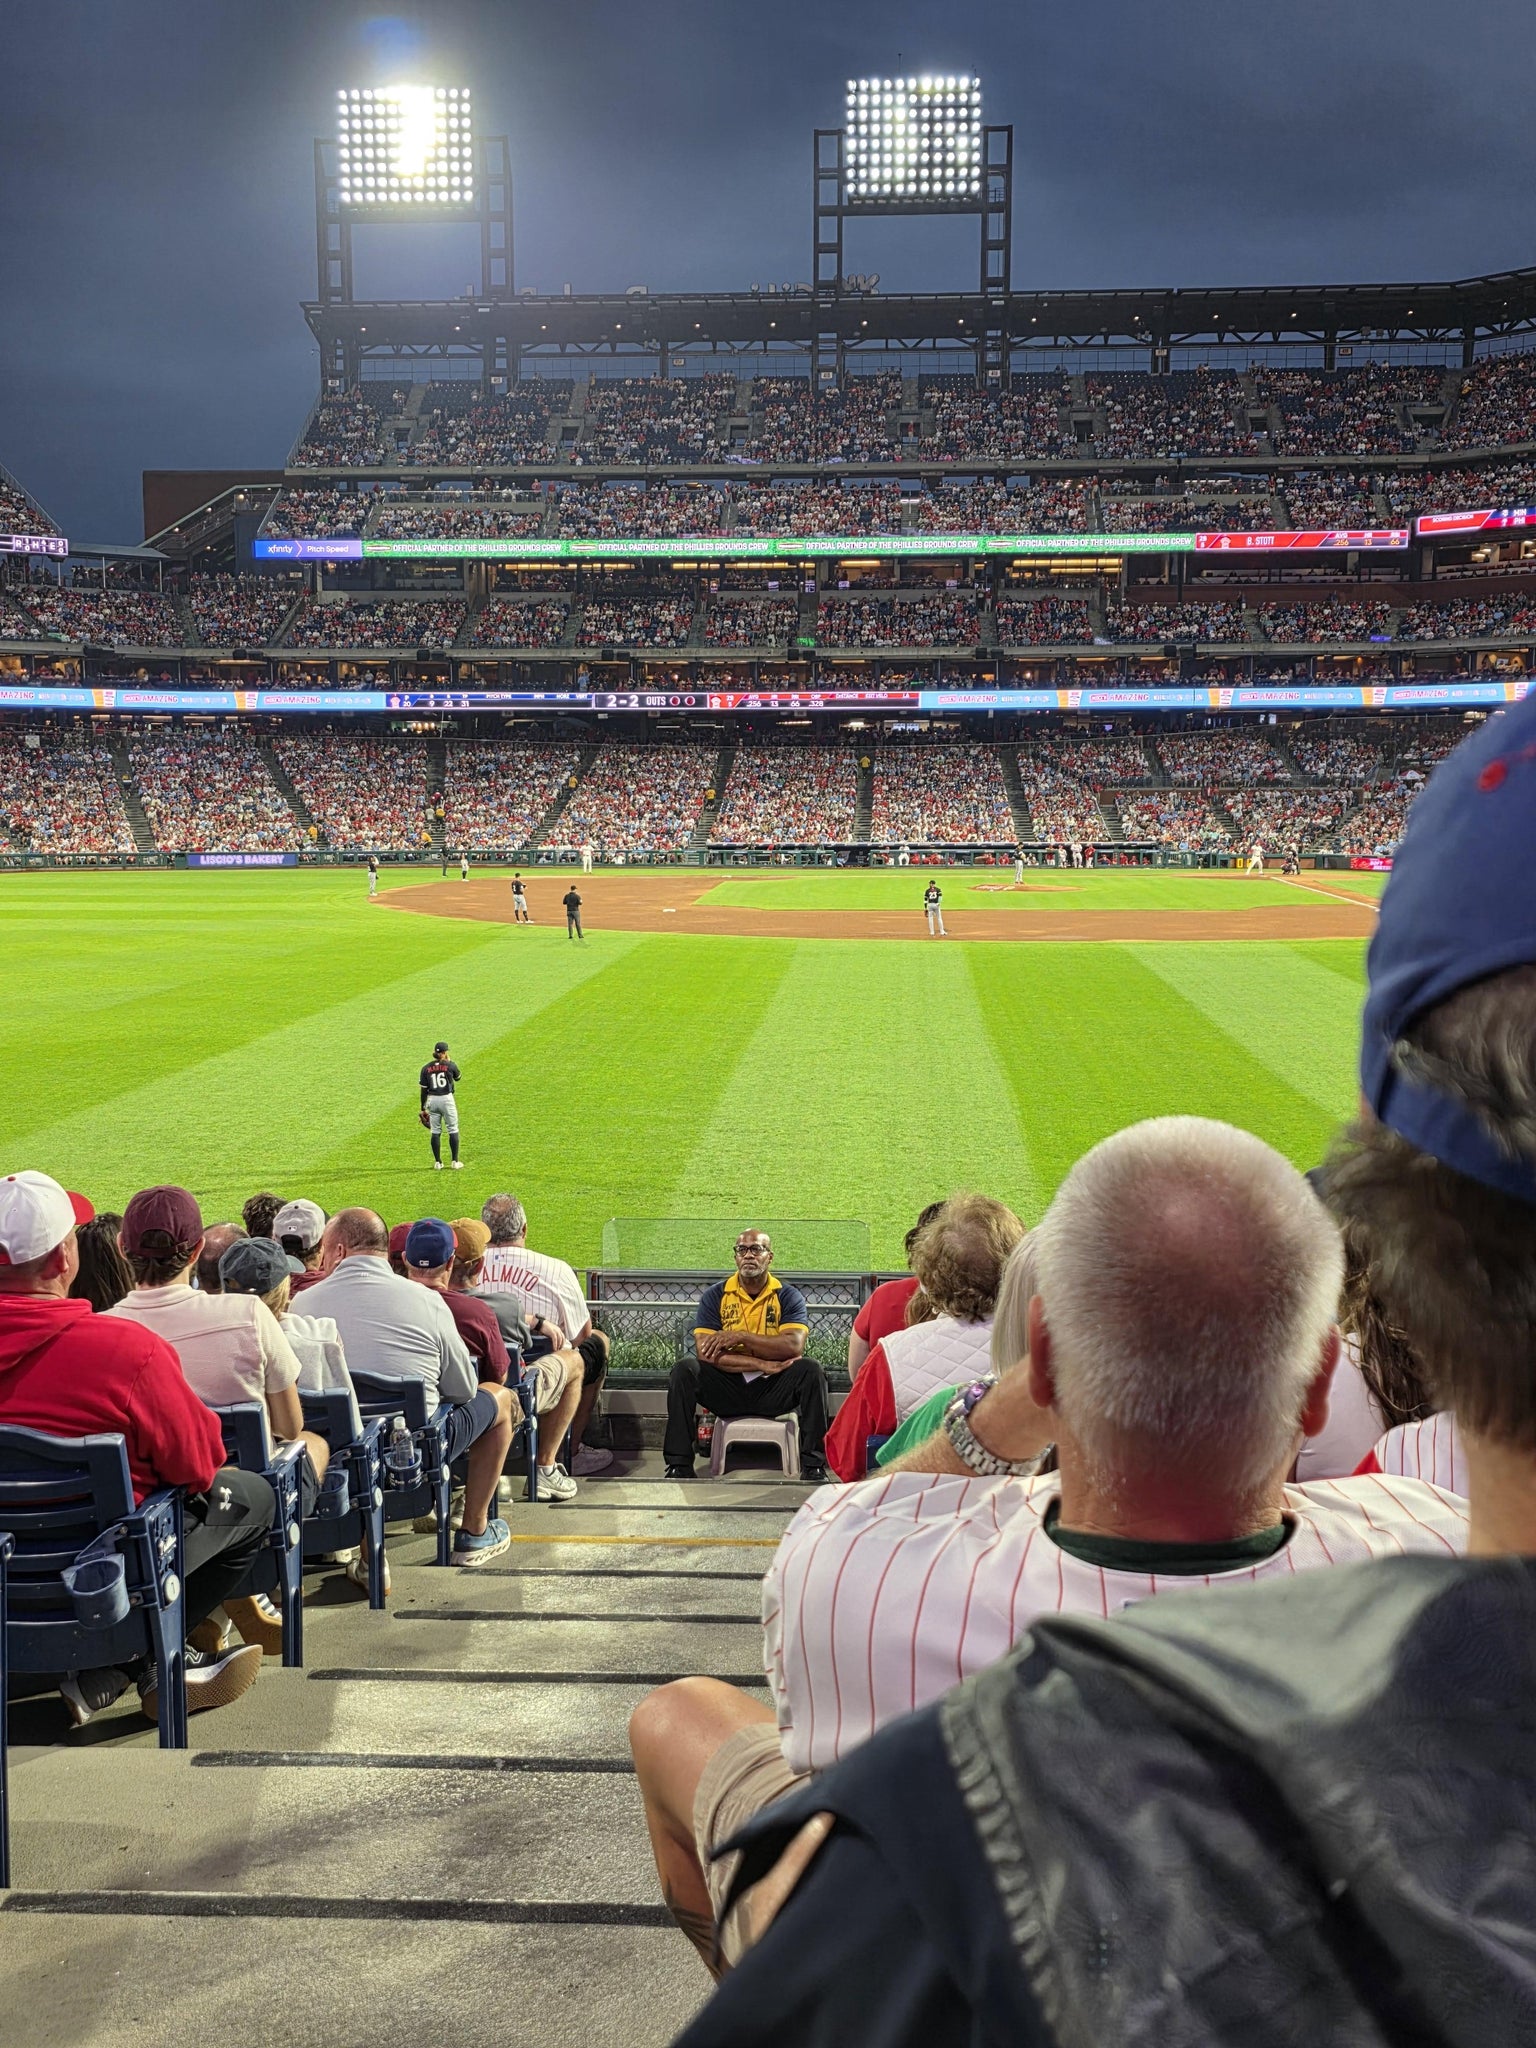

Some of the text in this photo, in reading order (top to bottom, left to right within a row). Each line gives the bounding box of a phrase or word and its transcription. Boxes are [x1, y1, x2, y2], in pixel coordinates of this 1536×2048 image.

[1514, 516, 1526, 526] PHI
[32, 541, 40, 549] H
[50, 542, 56, 550] E
[268, 544, 293, 554] xfinity
[142, 695, 178, 703] AMAZING
[1410, 690, 1448, 698] AMAZING
[646, 696, 666, 706] OUTS
[200, 854, 284, 865] LISCIO'S BAKERY
[431, 1072, 447, 1088] 16
